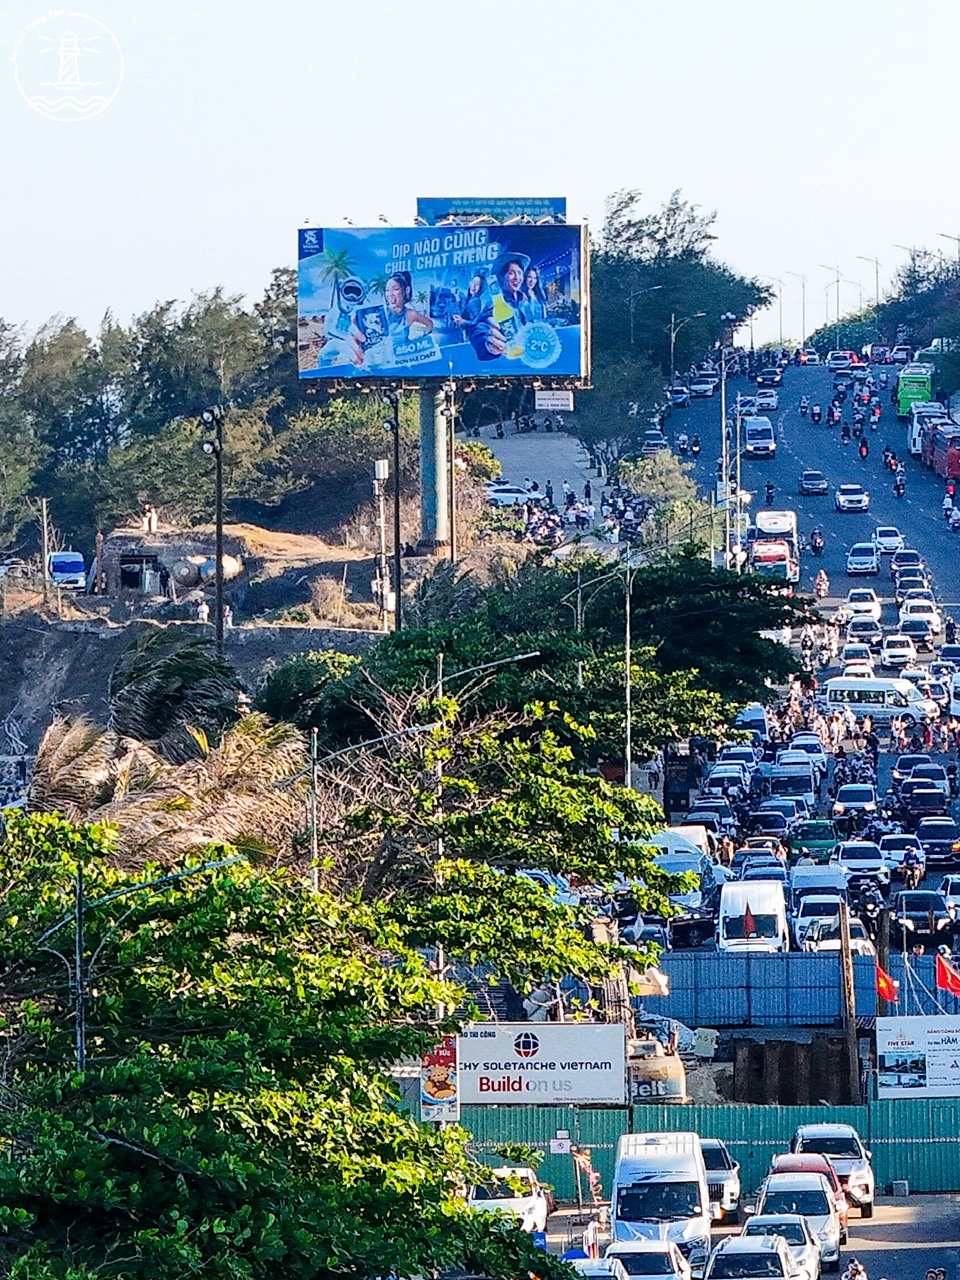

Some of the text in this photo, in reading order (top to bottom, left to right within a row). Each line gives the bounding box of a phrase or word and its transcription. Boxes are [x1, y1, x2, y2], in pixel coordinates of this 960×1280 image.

[479, 1076, 573, 1092] Build on us
